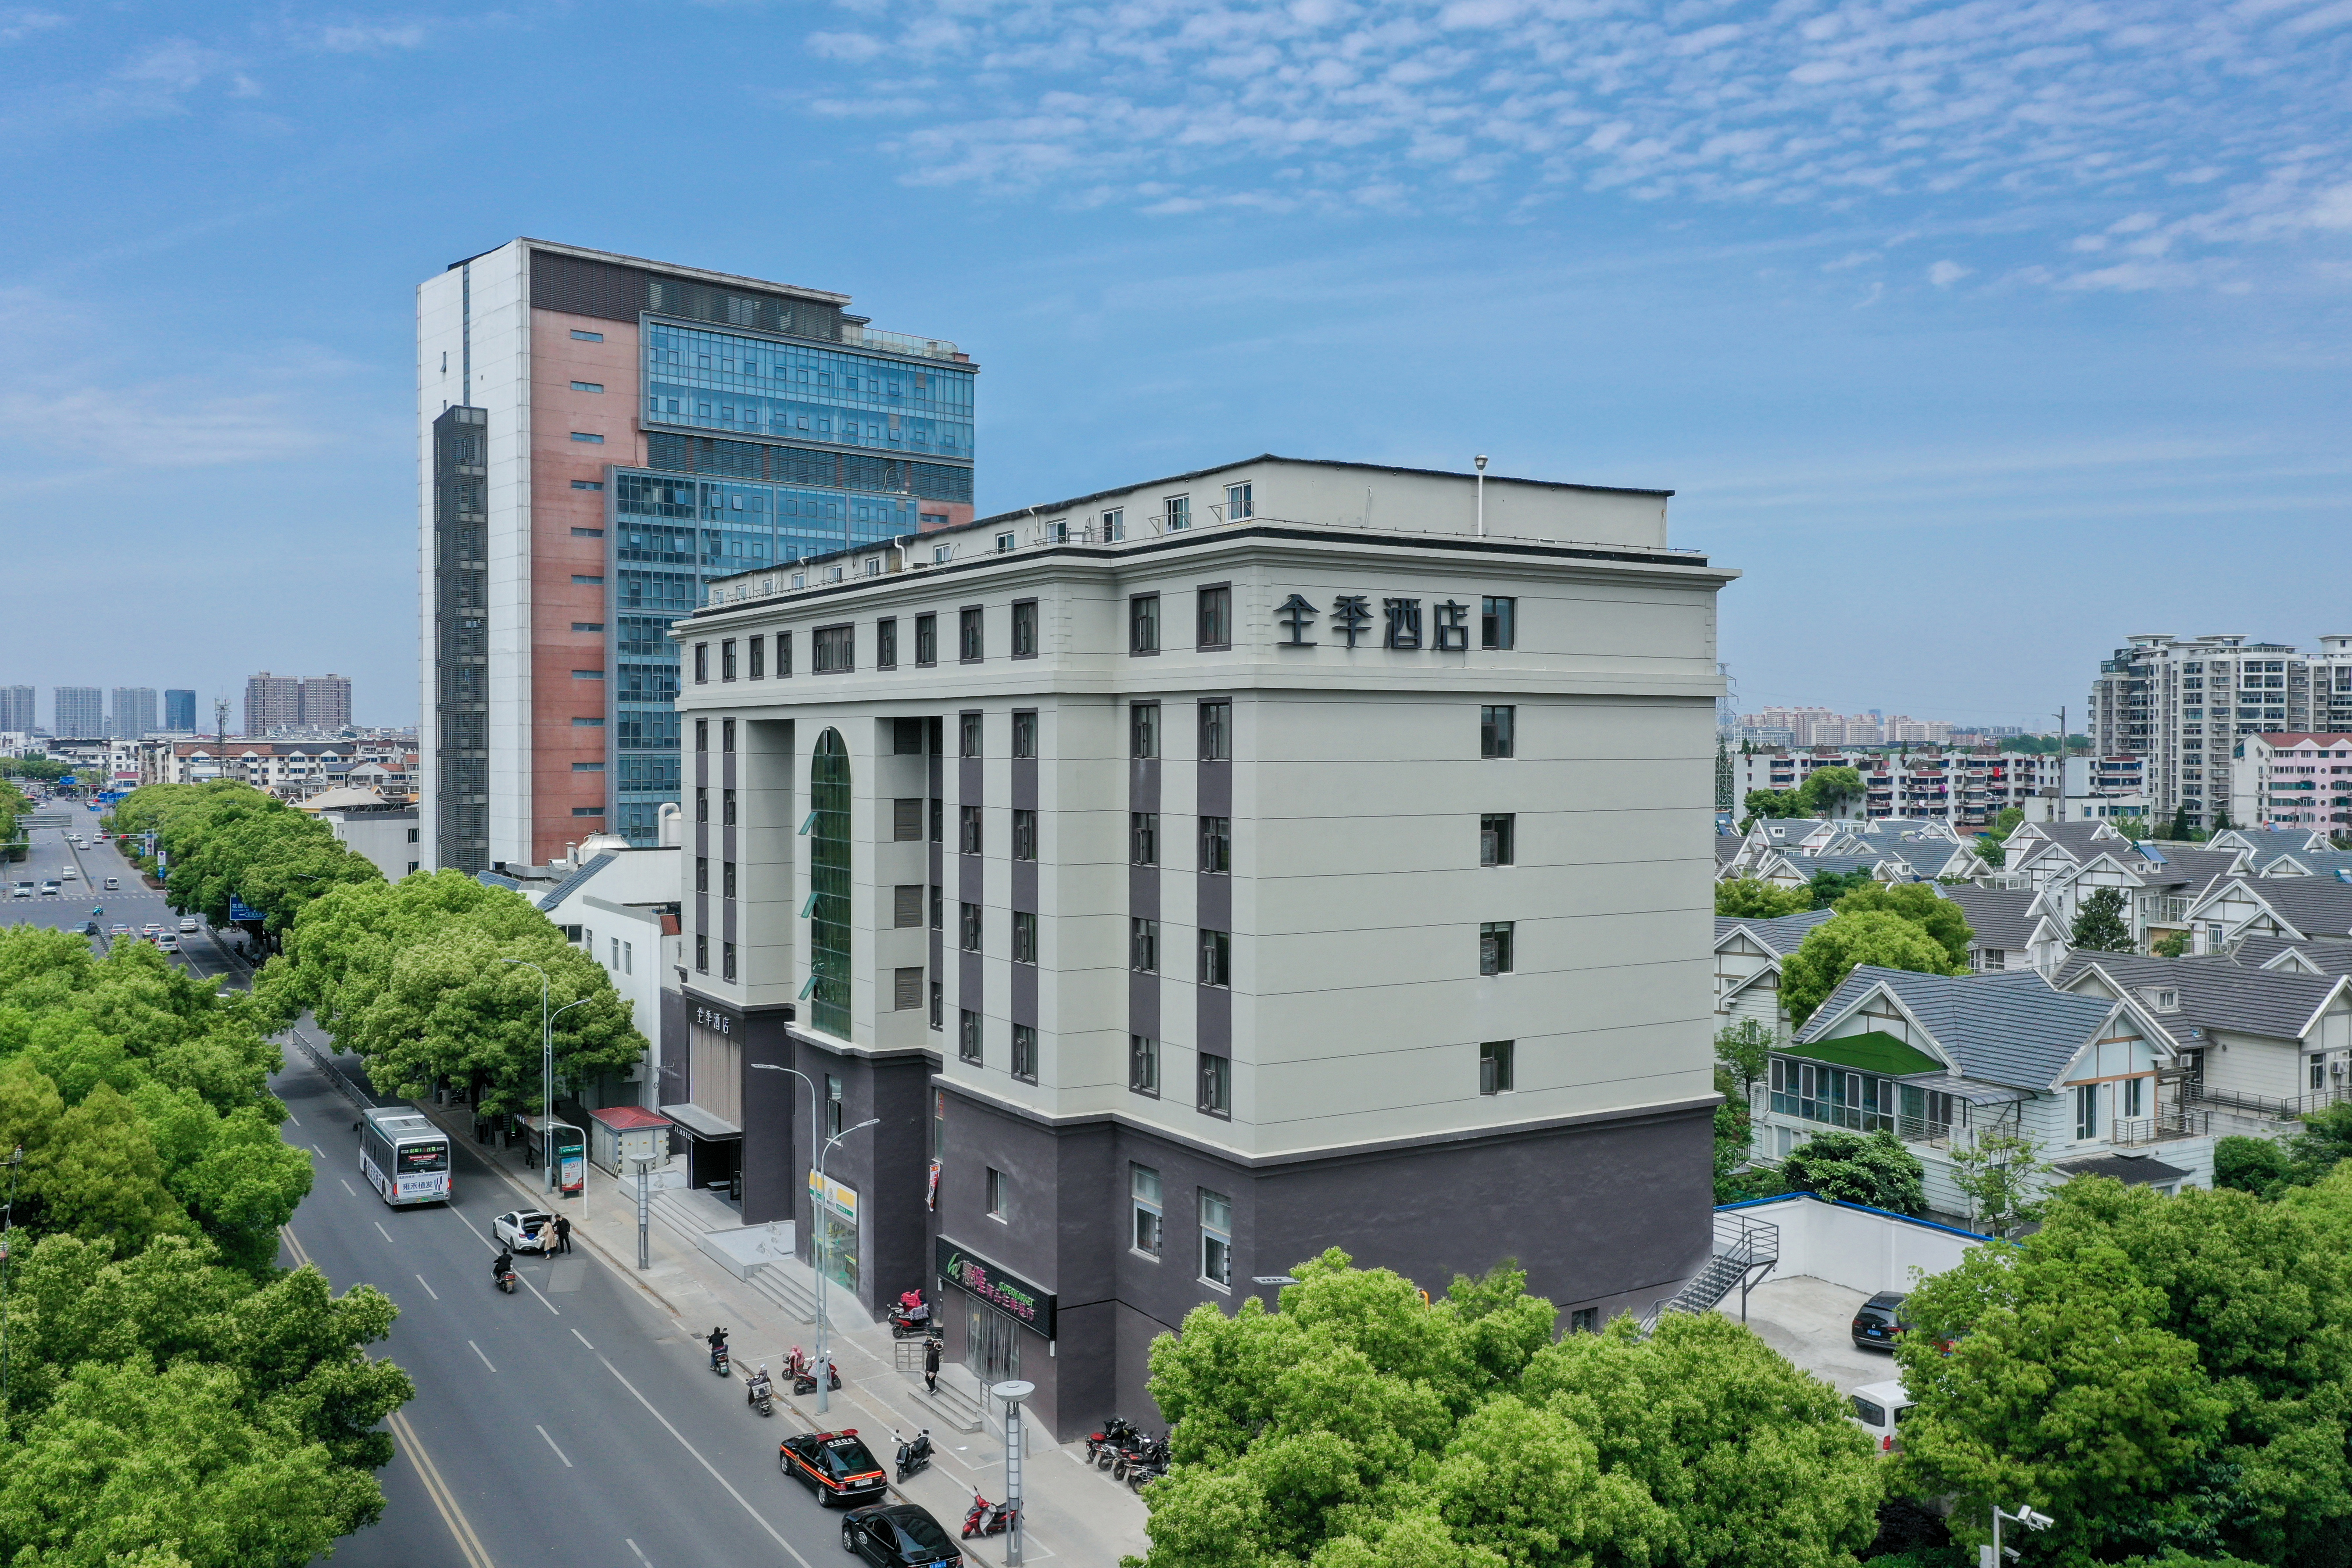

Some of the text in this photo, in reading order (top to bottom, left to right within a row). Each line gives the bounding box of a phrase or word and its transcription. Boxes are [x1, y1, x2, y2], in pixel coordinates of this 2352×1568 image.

[1274, 594, 1470, 650] 全季酒店
[697, 1007, 730, 1034] 全季酒店
[680, 1129, 693, 1141] HOTEL
[999, 1281, 1035, 1308] SUPERMARKET
[827, 1438, 855, 1446] 0508
